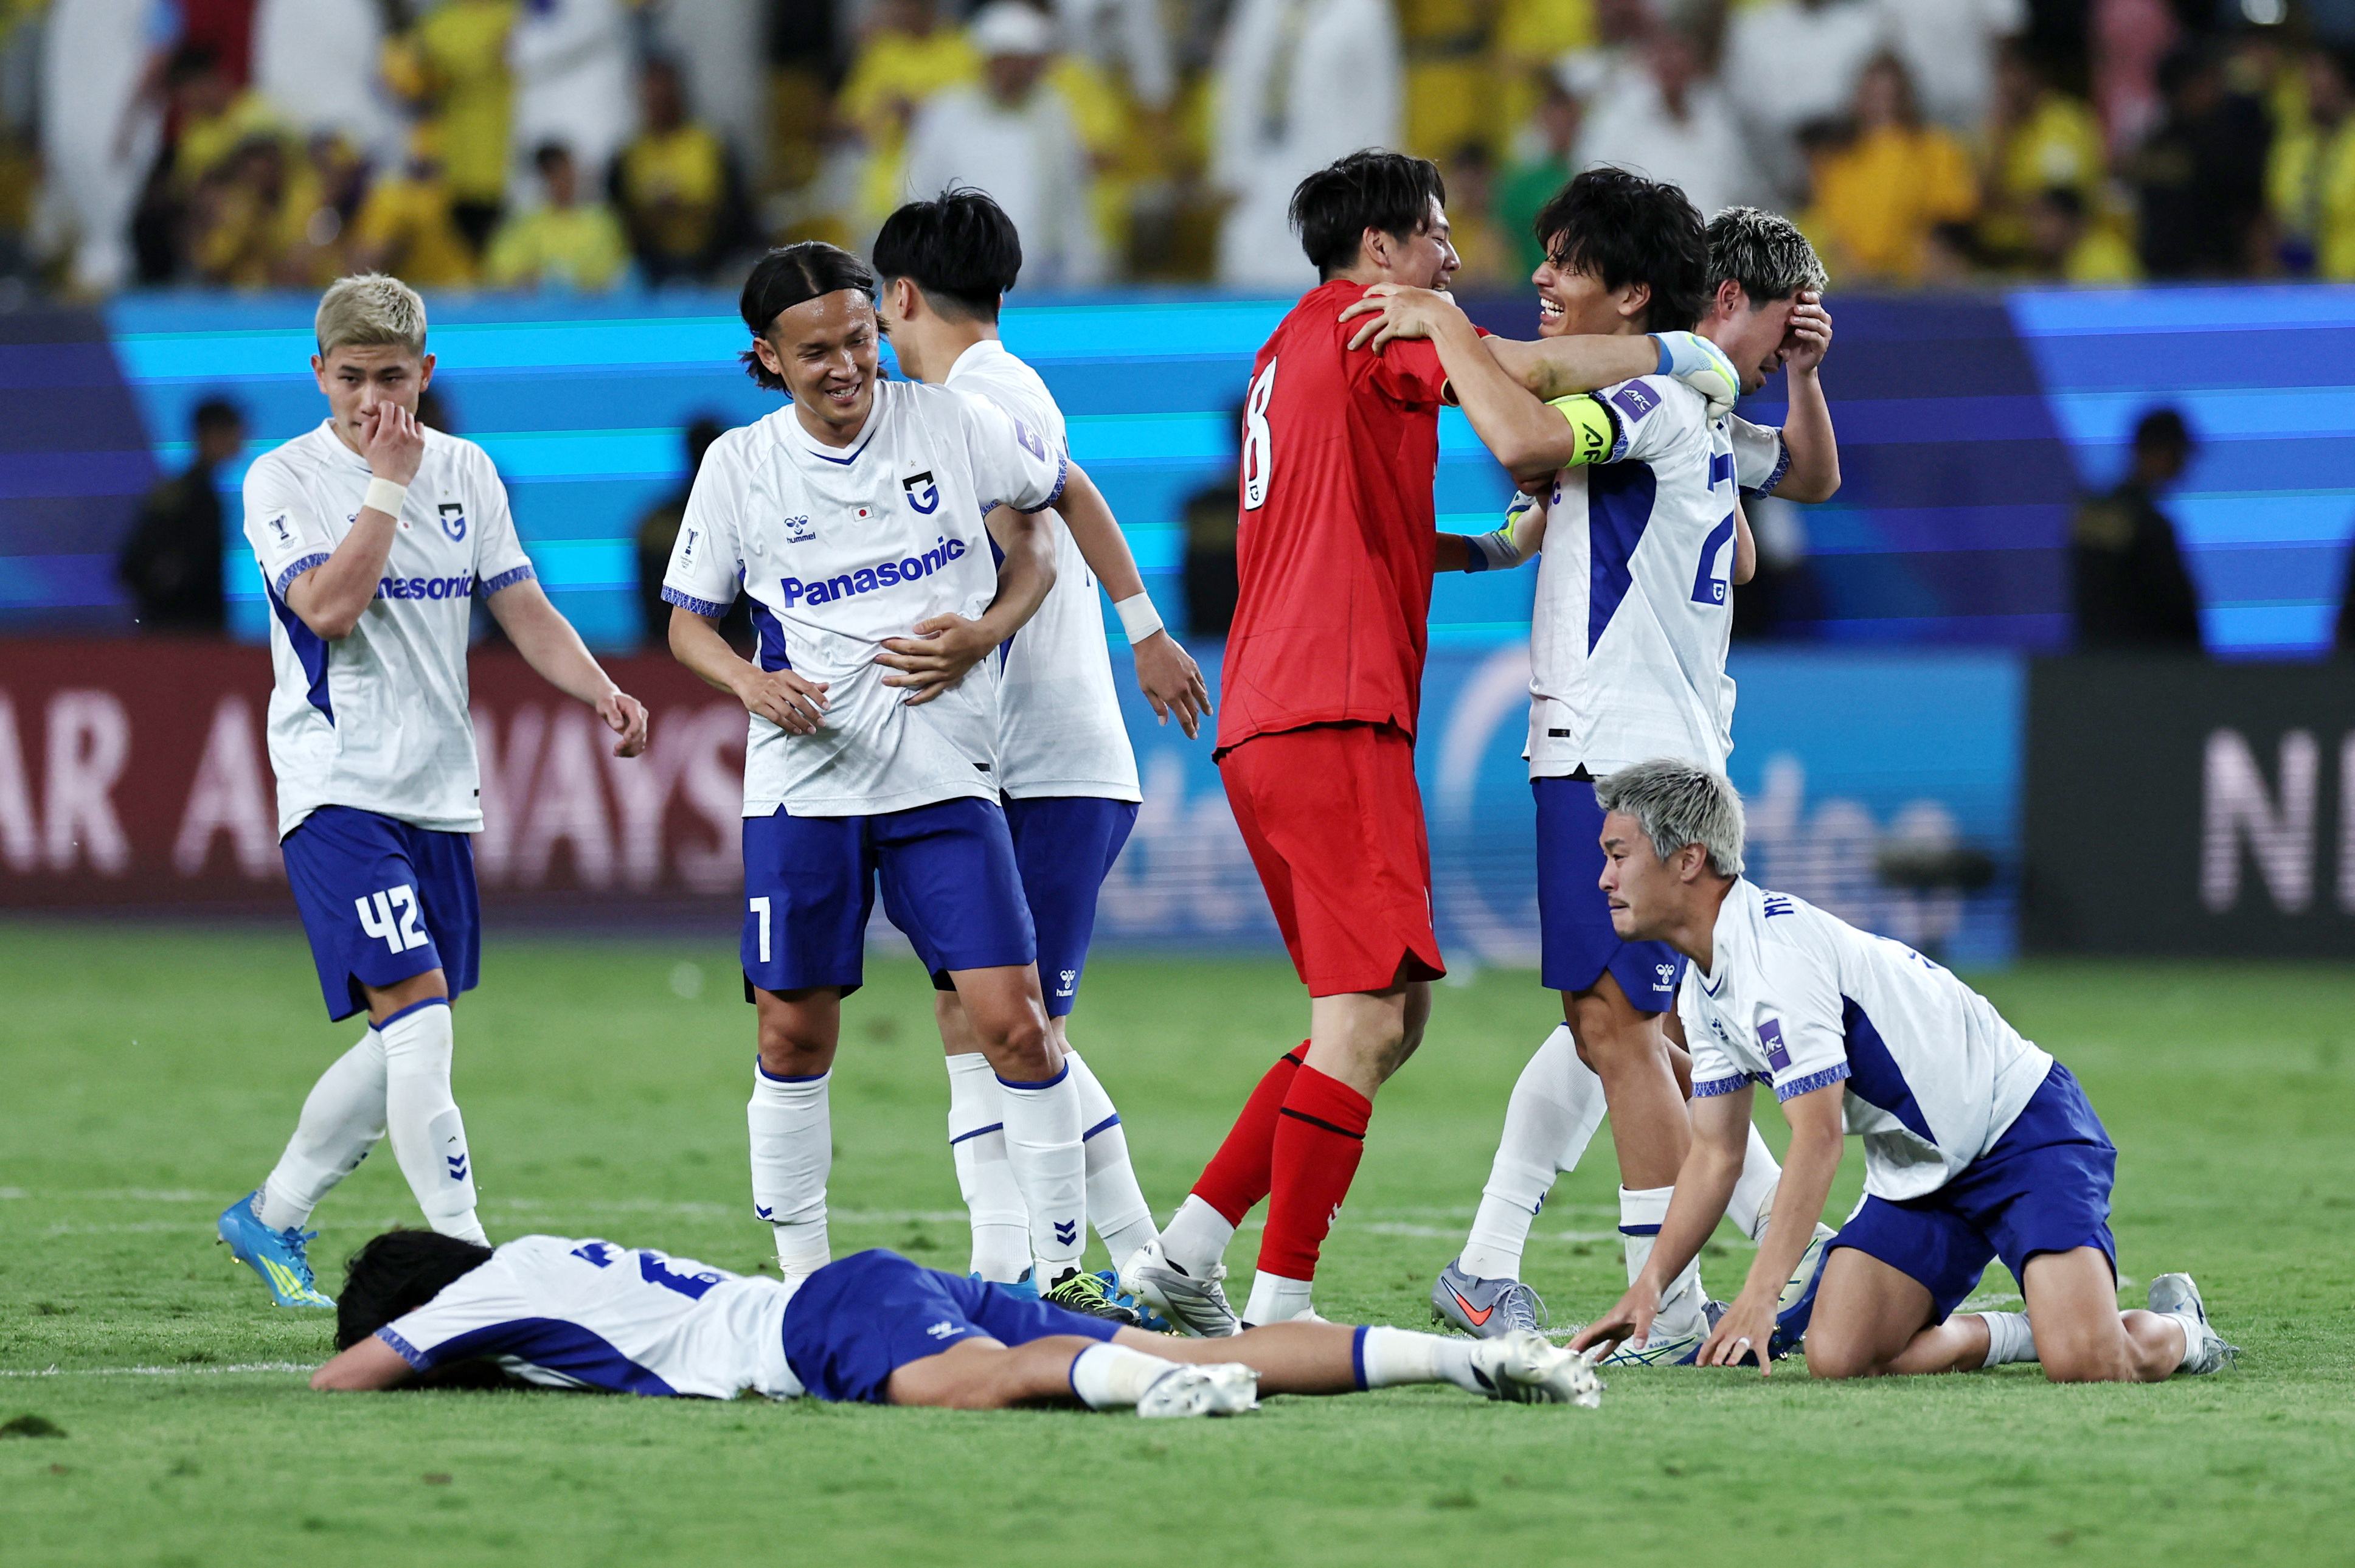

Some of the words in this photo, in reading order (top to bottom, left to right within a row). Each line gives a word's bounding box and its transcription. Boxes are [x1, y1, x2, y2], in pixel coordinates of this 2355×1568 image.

[1623, 389, 1653, 411] AFC
[1241, 356, 1277, 511] 8
[1582, 423, 1604, 462] AF
[786, 532, 816, 544] hummel
[1691, 451, 1738, 606] 2
[373, 569, 472, 600] nasonic
[780, 536, 965, 608] Panasonic
[355, 884, 429, 954] 42
[1766, 1035, 1782, 1055] AFC
